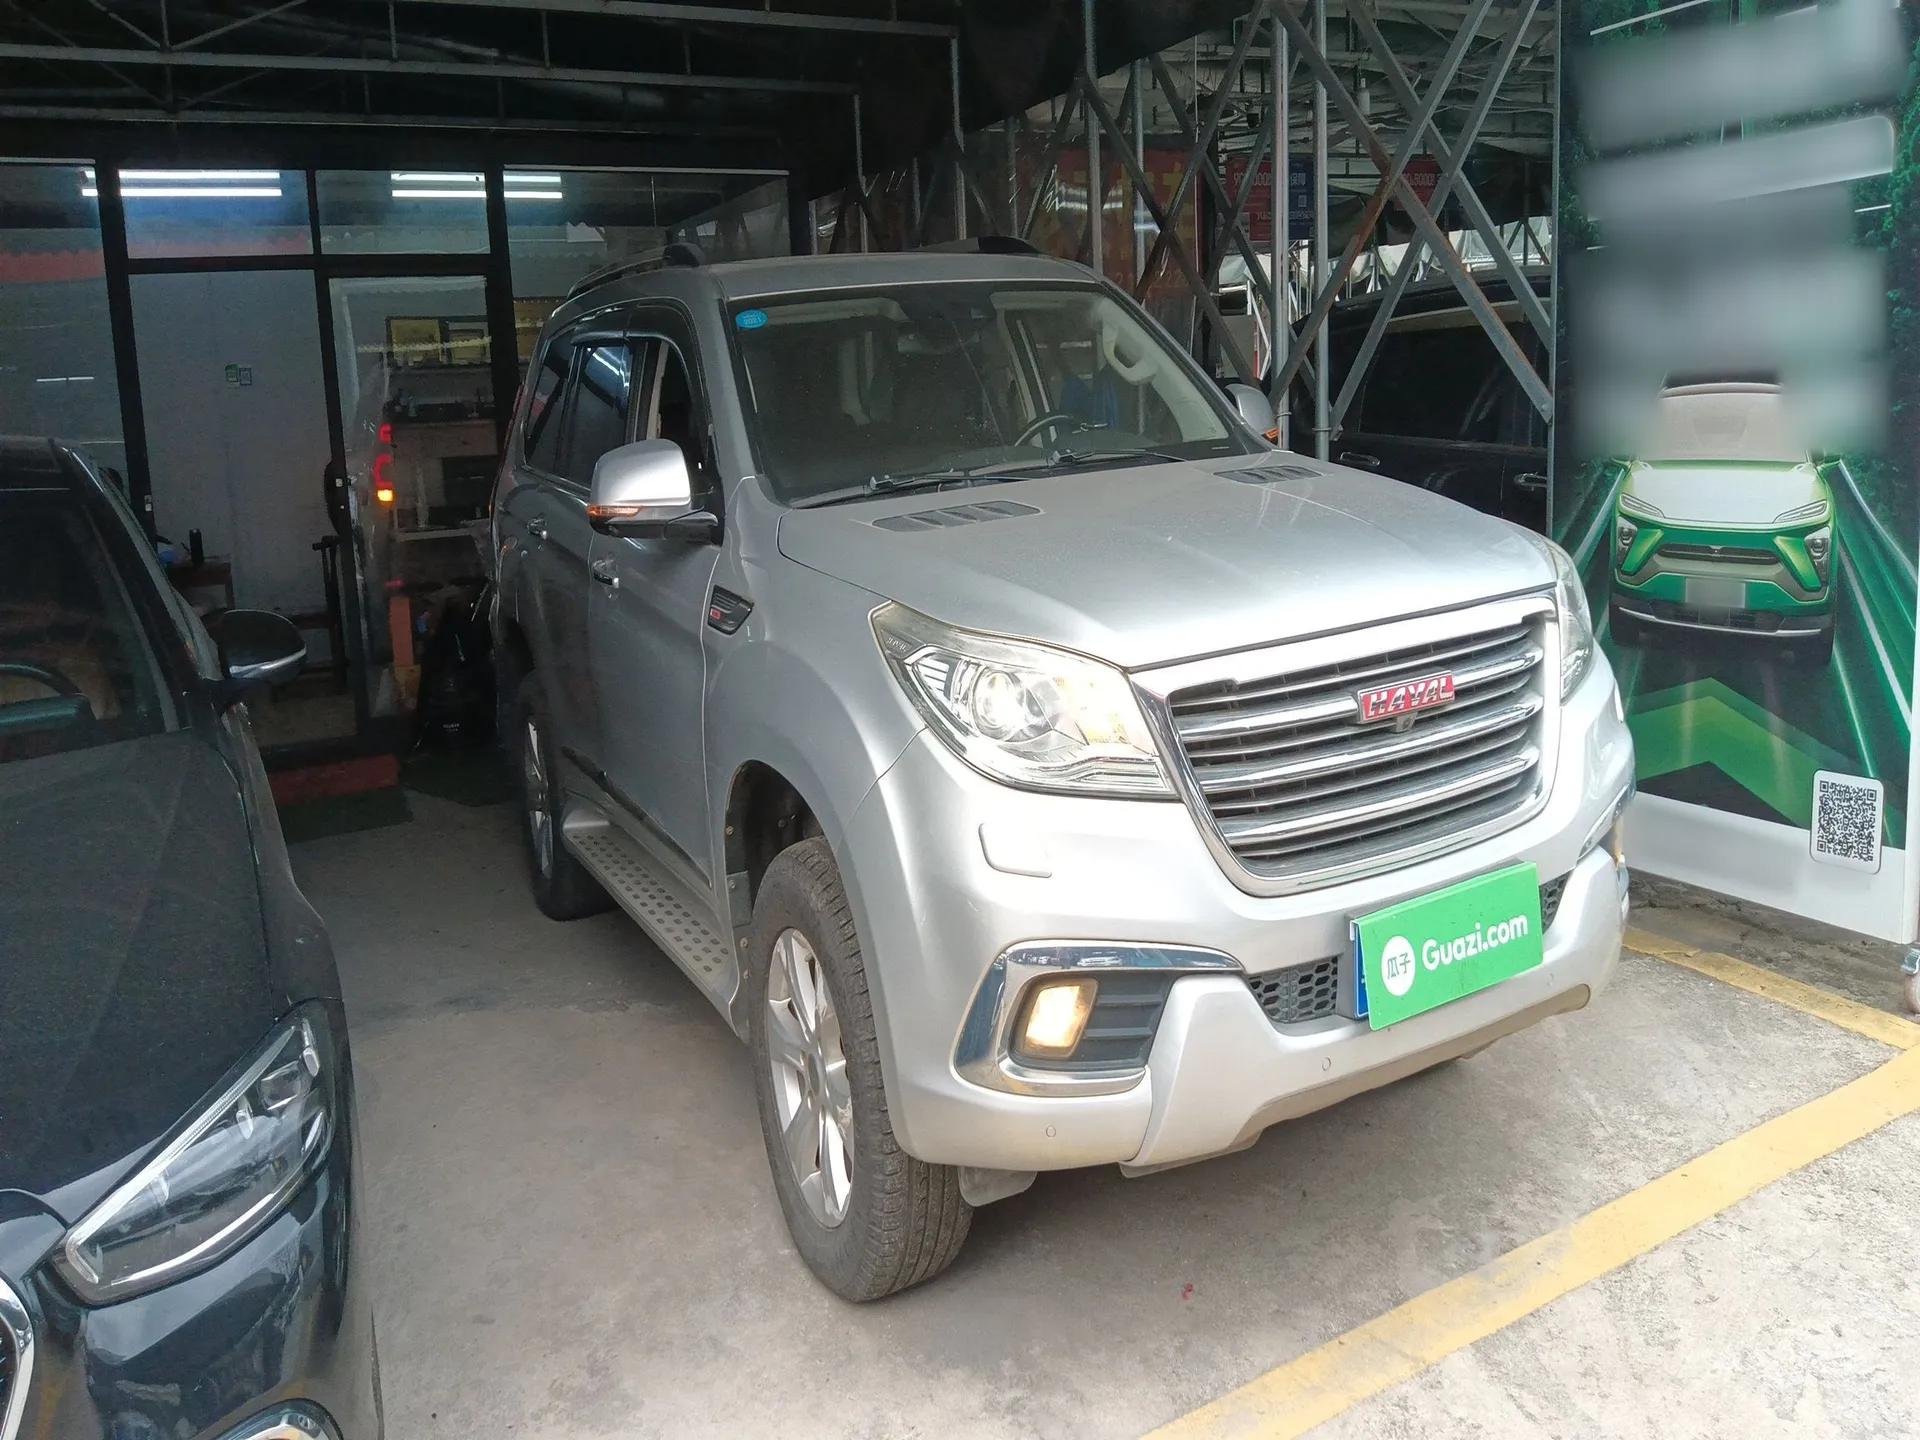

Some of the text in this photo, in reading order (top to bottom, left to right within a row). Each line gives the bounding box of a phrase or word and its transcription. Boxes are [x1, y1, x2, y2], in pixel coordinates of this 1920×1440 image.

[1367, 676, 1454, 717] HAVAL
[1387, 915, 1529, 980] 瓜子 Guazi.com
